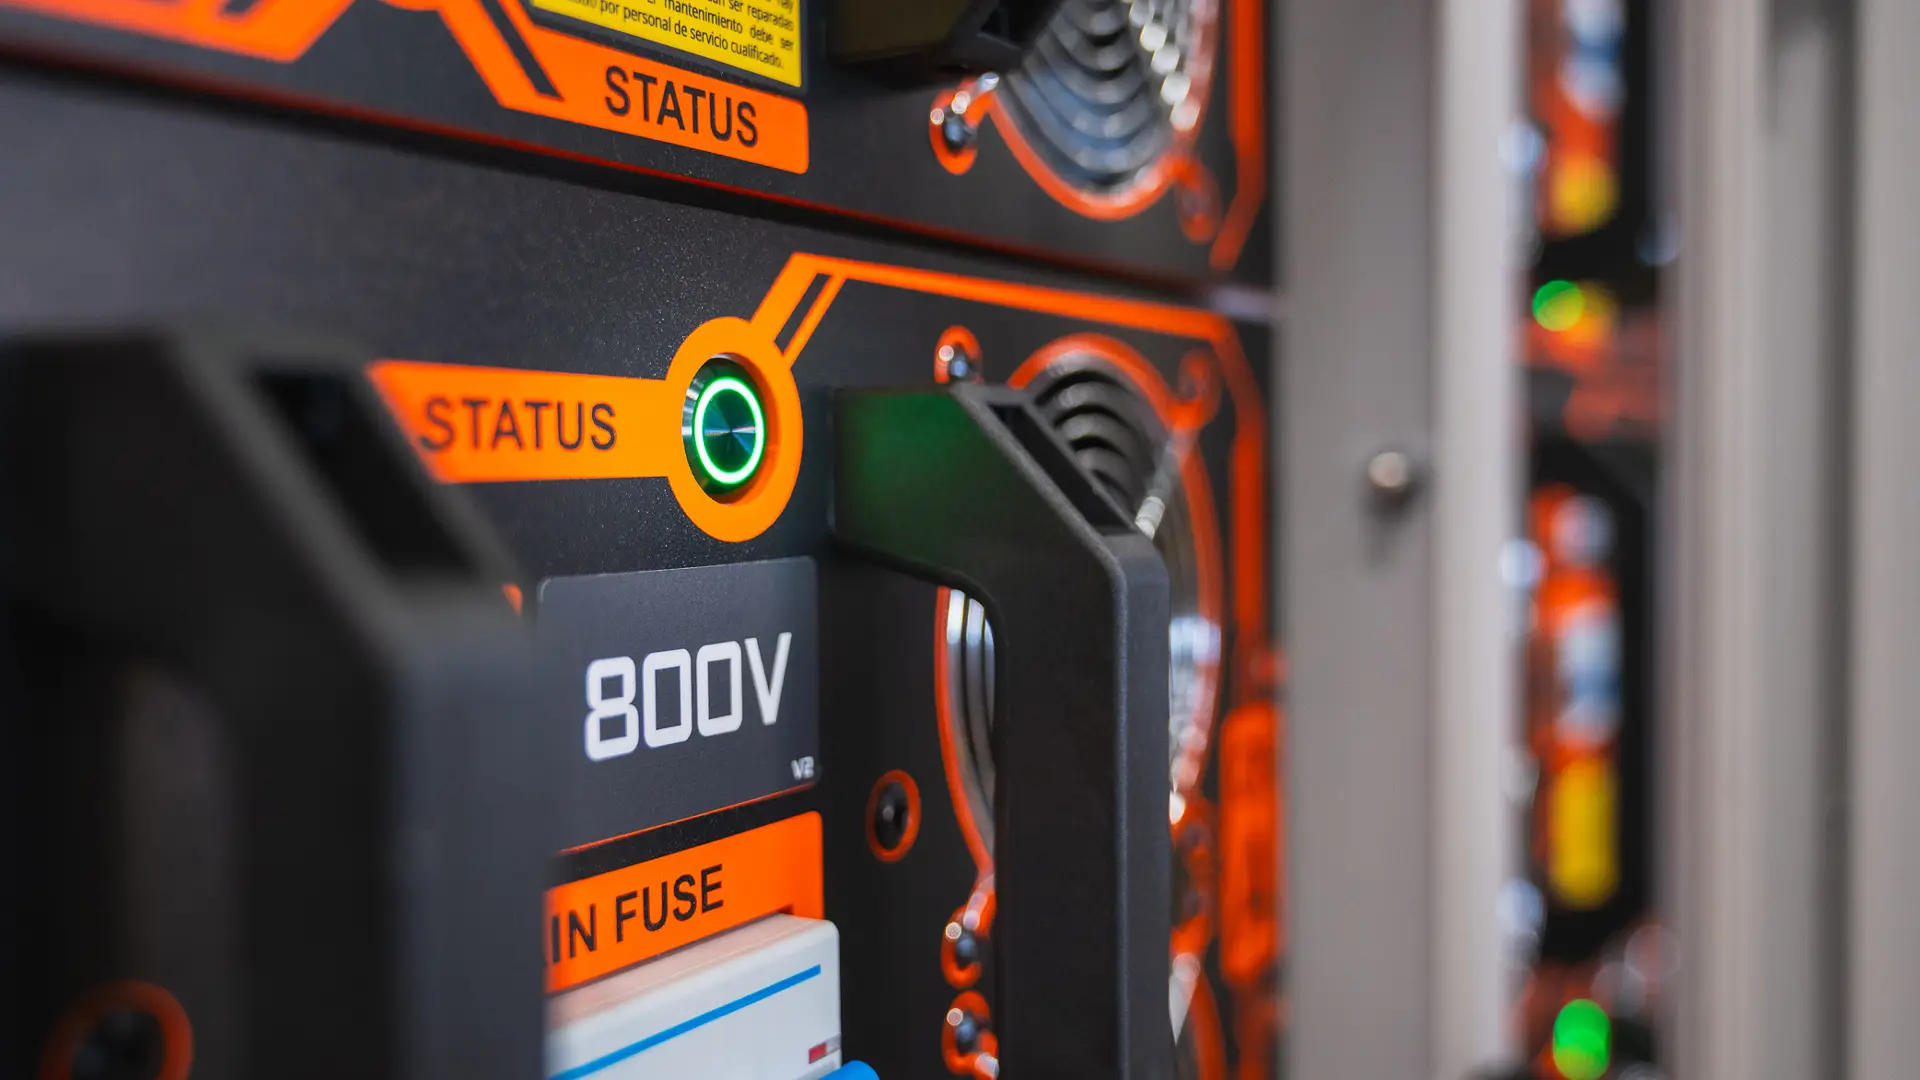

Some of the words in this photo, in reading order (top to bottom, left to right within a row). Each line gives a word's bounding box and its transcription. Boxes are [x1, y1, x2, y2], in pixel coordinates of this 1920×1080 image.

[599, 0, 620, 16] por
[623, 5, 671, 32] personal
[674, 20, 688, 38] de
[690, 28, 729, 50] servicio
[731, 41, 784, 70] cualificado.
[664, 0, 743, 34] mantenimiento
[749, 24, 774, 46] debe
[728, 0, 744, 13] ser
[747, 4, 795, 32] reparadas
[604, 64, 759, 148] STATUS
[419, 397, 617, 451] STATUS
[584, 631, 793, 762] 800V
[790, 756, 815, 780] V2
[545, 903, 598, 965] IN
[616, 863, 725, 944] FUSE
